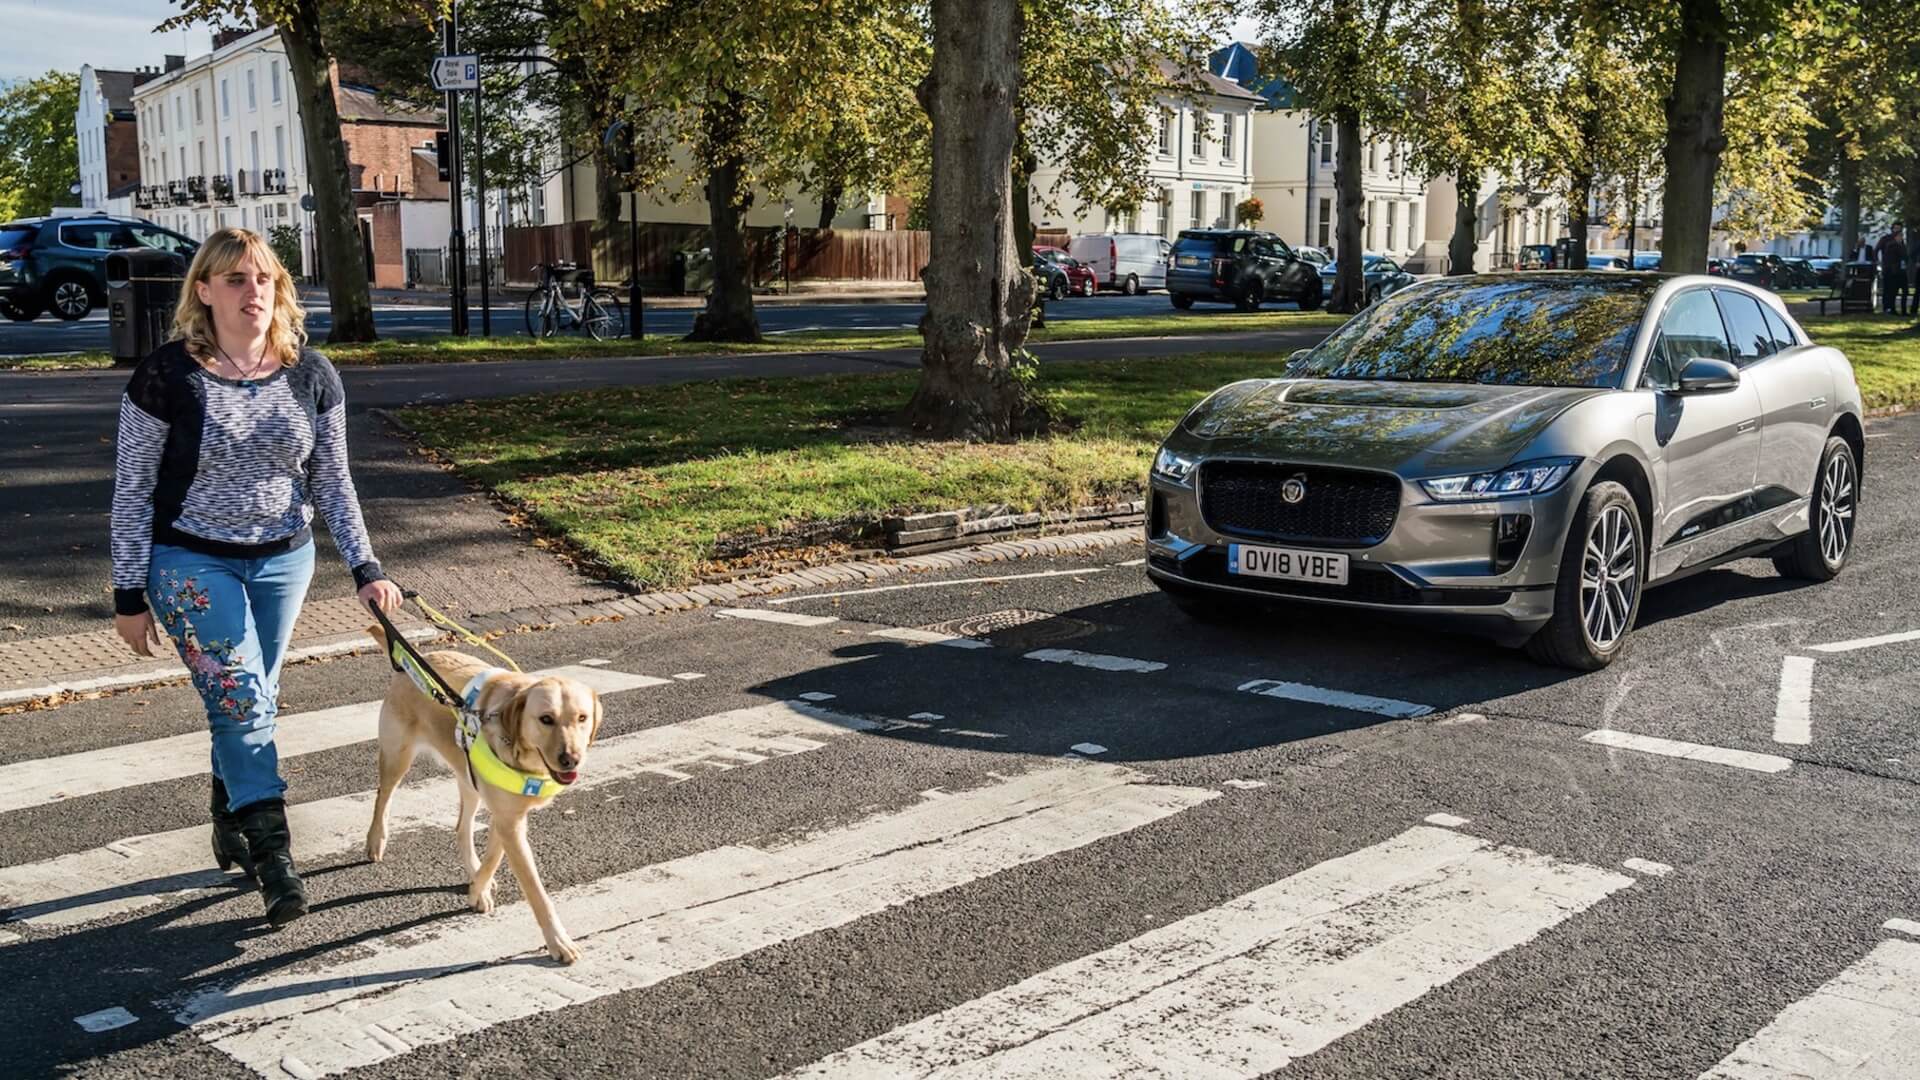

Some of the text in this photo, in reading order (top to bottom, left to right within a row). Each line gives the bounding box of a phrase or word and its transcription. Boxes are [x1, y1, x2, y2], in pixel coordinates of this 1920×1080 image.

[444, 60, 460, 68] Royal
[443, 78, 462, 86] Centre
[1246, 550, 1339, 579] OV18 VBE
